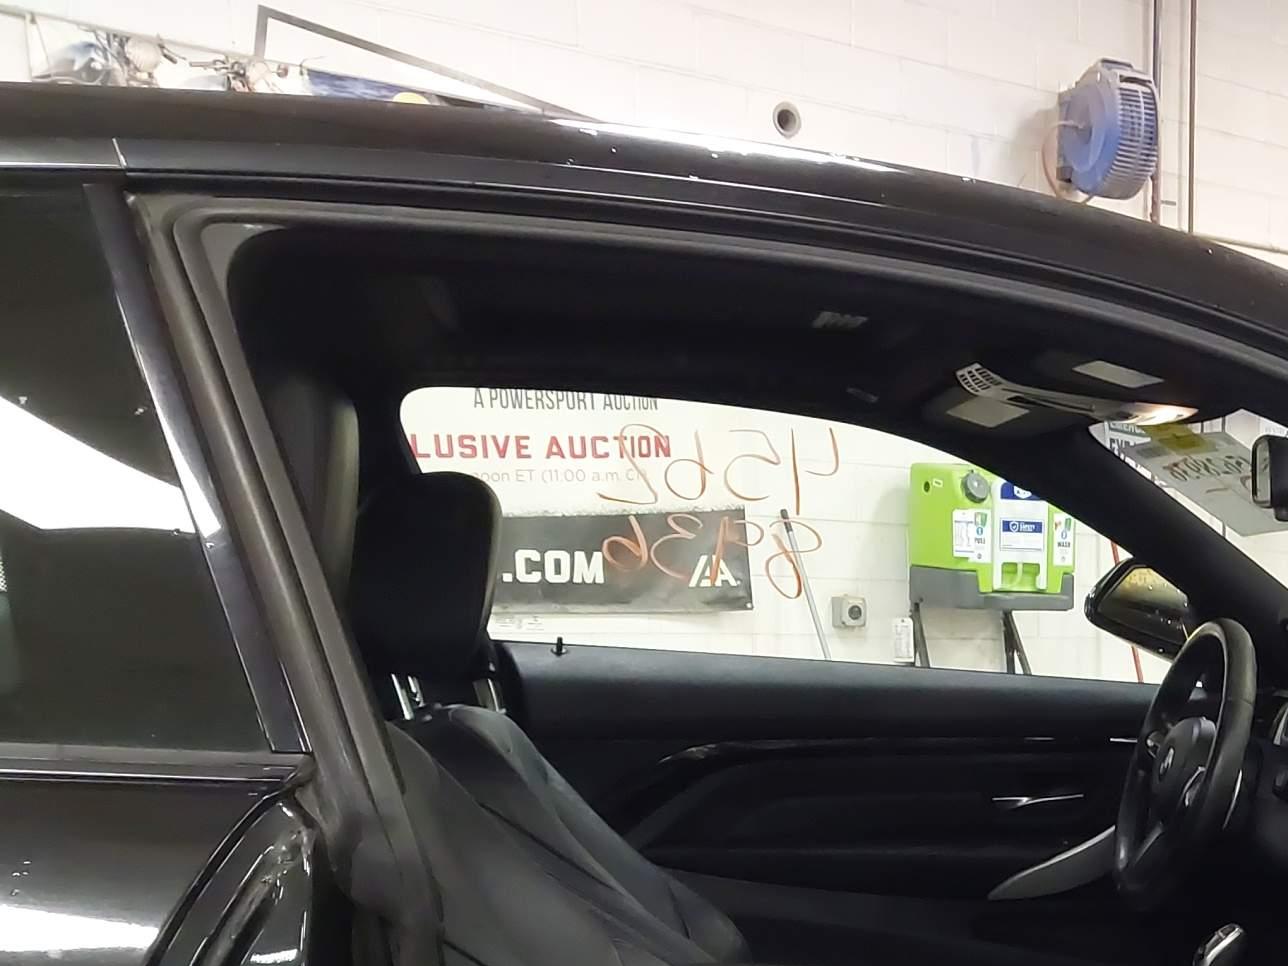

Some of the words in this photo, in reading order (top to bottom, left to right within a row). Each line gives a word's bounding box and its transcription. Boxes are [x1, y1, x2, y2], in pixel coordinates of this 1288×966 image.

[474, 387, 484, 408] A
[488, 388, 595, 411] POWERSPORT
[545, 435, 671, 459] AUCTION
[515, 469, 535, 481] ET
[502, 549, 605, 584] .COM
